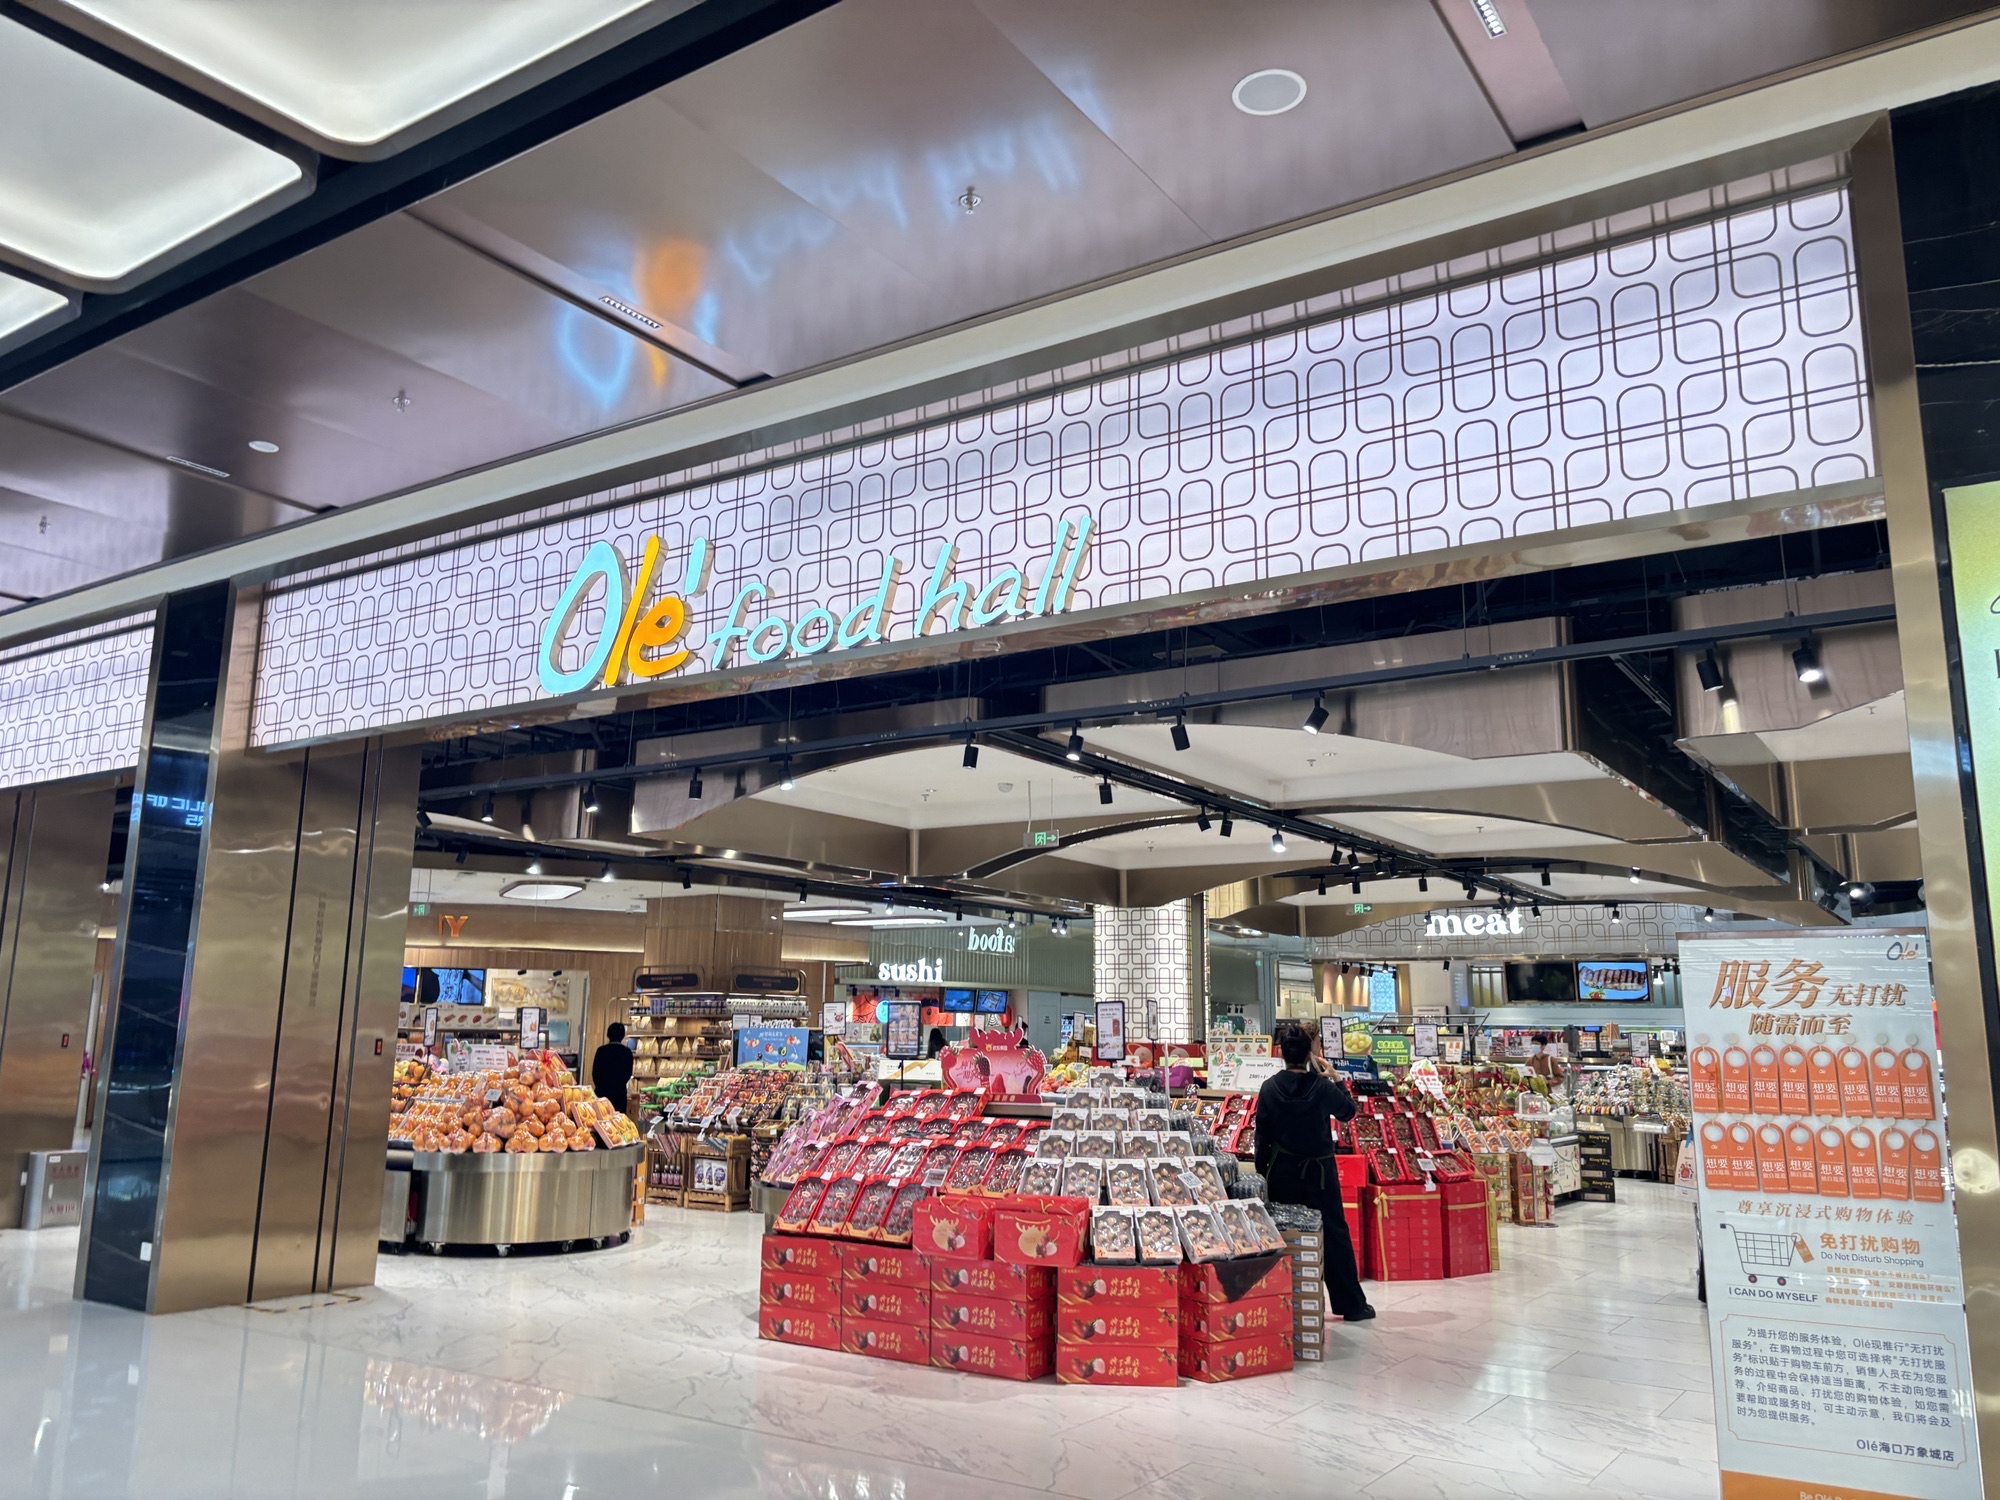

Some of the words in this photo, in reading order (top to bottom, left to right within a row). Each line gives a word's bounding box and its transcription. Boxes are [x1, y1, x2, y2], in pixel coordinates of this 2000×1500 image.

[706, 555, 901, 670] food
[913, 515, 1098, 637] hall
[1424, 907, 1524, 937] meat
[878, 957, 943, 983] sushi
[1709, 958, 1831, 1010] 服务
[1826, 983, 1908, 1007] 无打扰
[1748, 1013, 1853, 1036] 随需而至
[1725, 1082, 1747, 1093] 想要
[1754, 1081, 1777, 1092] 想要
[1782, 1081, 1805, 1093] 想要
[1813, 1083, 1836, 1094] 想要
[1844, 1084, 1868, 1094] 想要
[1875, 1085, 1899, 1096] 想要
[1904, 1086, 1928, 1097] 想要
[1706, 1158, 1728, 1169] 想要
[1732, 1160, 1754, 1170] 想要
[1762, 1161, 1784, 1172] 想要
[1790, 1159, 1813, 1170] 想要
[1820, 1164, 1843, 1175] 想要
[1852, 1166, 1876, 1177] 想要
[1882, 1166, 1907, 1179] 想要
[1914, 1168, 1938, 1180] 想要
[1738, 1200, 1915, 1225] 尊享沉浸式购物体验
[1820, 1232, 1921, 1256] 免打扰购物
[1821, 1252, 1832, 1260] Do
[1834, 1252, 1850, 1262] Not
[1851, 1253, 1882, 1264] Disturb
[1884, 1256, 1924, 1268] Shopping
[1728, 1287, 1732, 1295] I
[1734, 1288, 1756, 1298] CAN
[1758, 1290, 1774, 1299] DO
[1776, 1291, 1818, 1303] MYSELF
[1737, 1406, 1815, 1426] 时为您提供服务。
[1856, 1439, 1954, 1462] Olé海口万象城店
